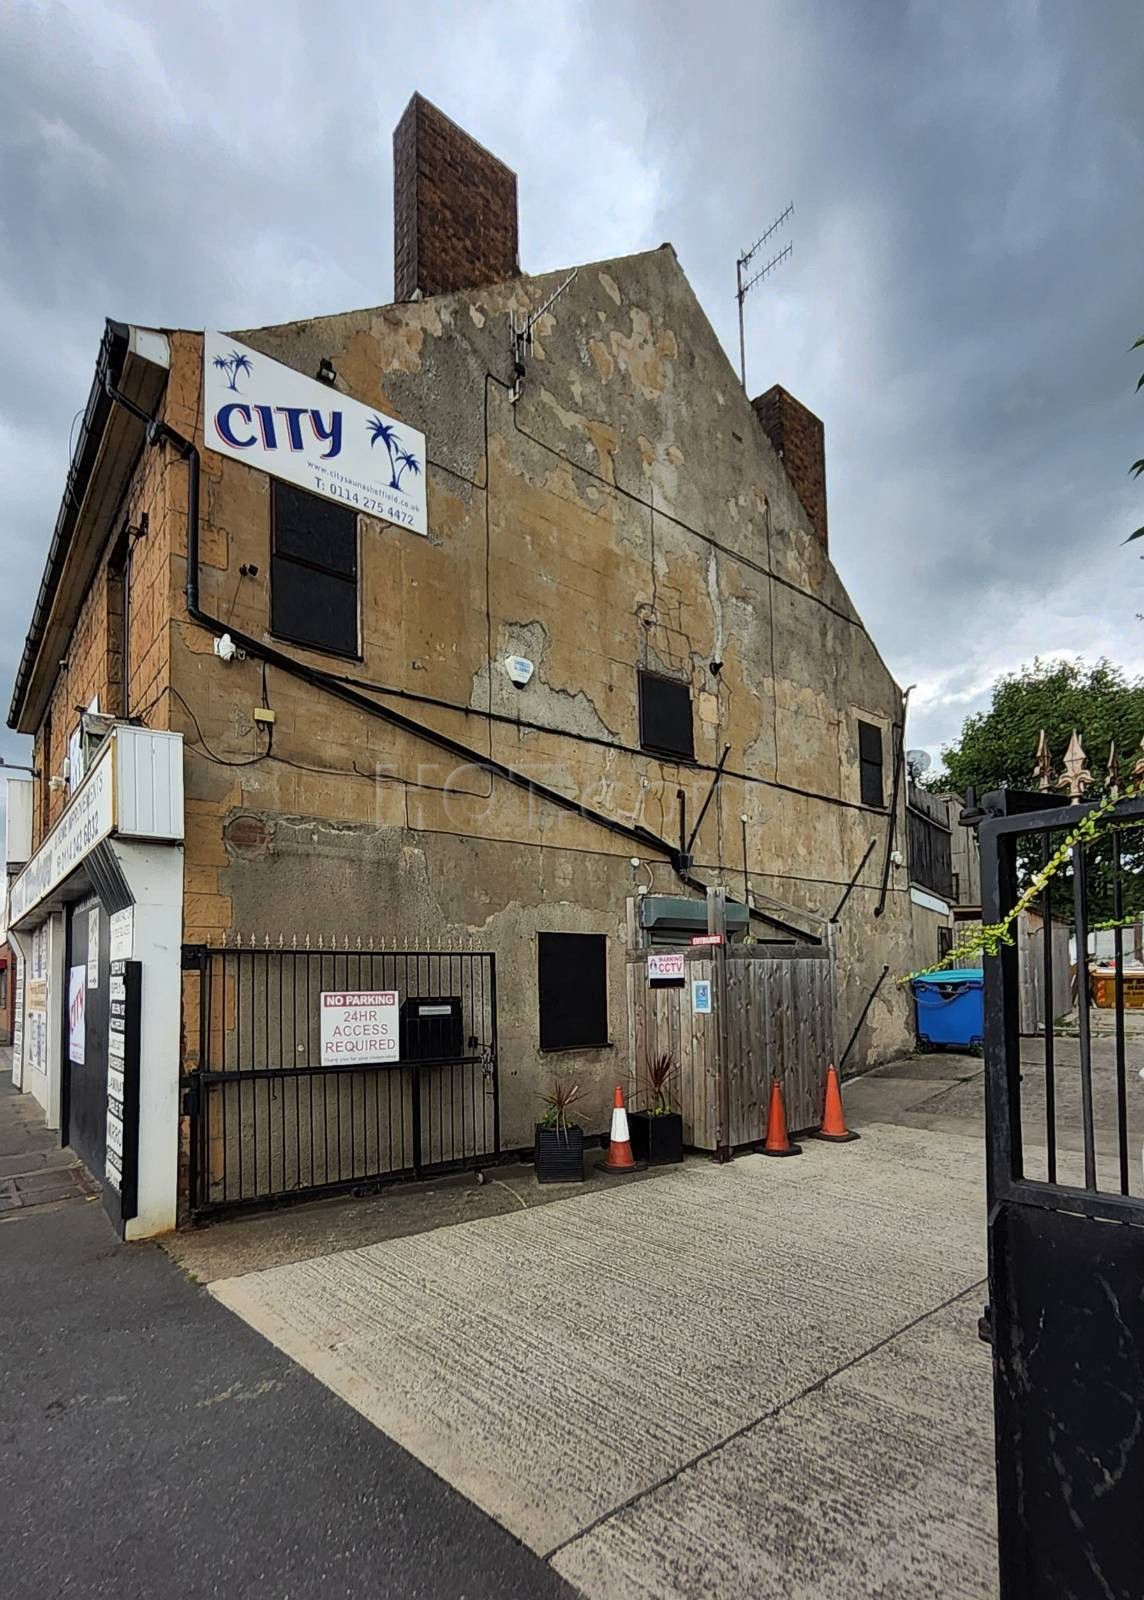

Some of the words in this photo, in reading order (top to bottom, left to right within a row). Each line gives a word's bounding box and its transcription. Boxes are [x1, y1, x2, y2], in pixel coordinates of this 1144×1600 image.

[213, 402, 343, 460] CITY
[314, 476, 325, 491] T:
[329, 483, 359, 504] 0114
[363, 495, 384, 514] 275
[387, 507, 415, 526] 4472
[658, 962, 683, 973] CCTV
[327, 996, 343, 1006] NO
[346, 995, 393, 1005] PARKING
[343, 1011, 377, 1022] 24HR
[332, 1023, 389, 1037] ACCESS
[325, 1039, 396, 1053] REQUIRED
